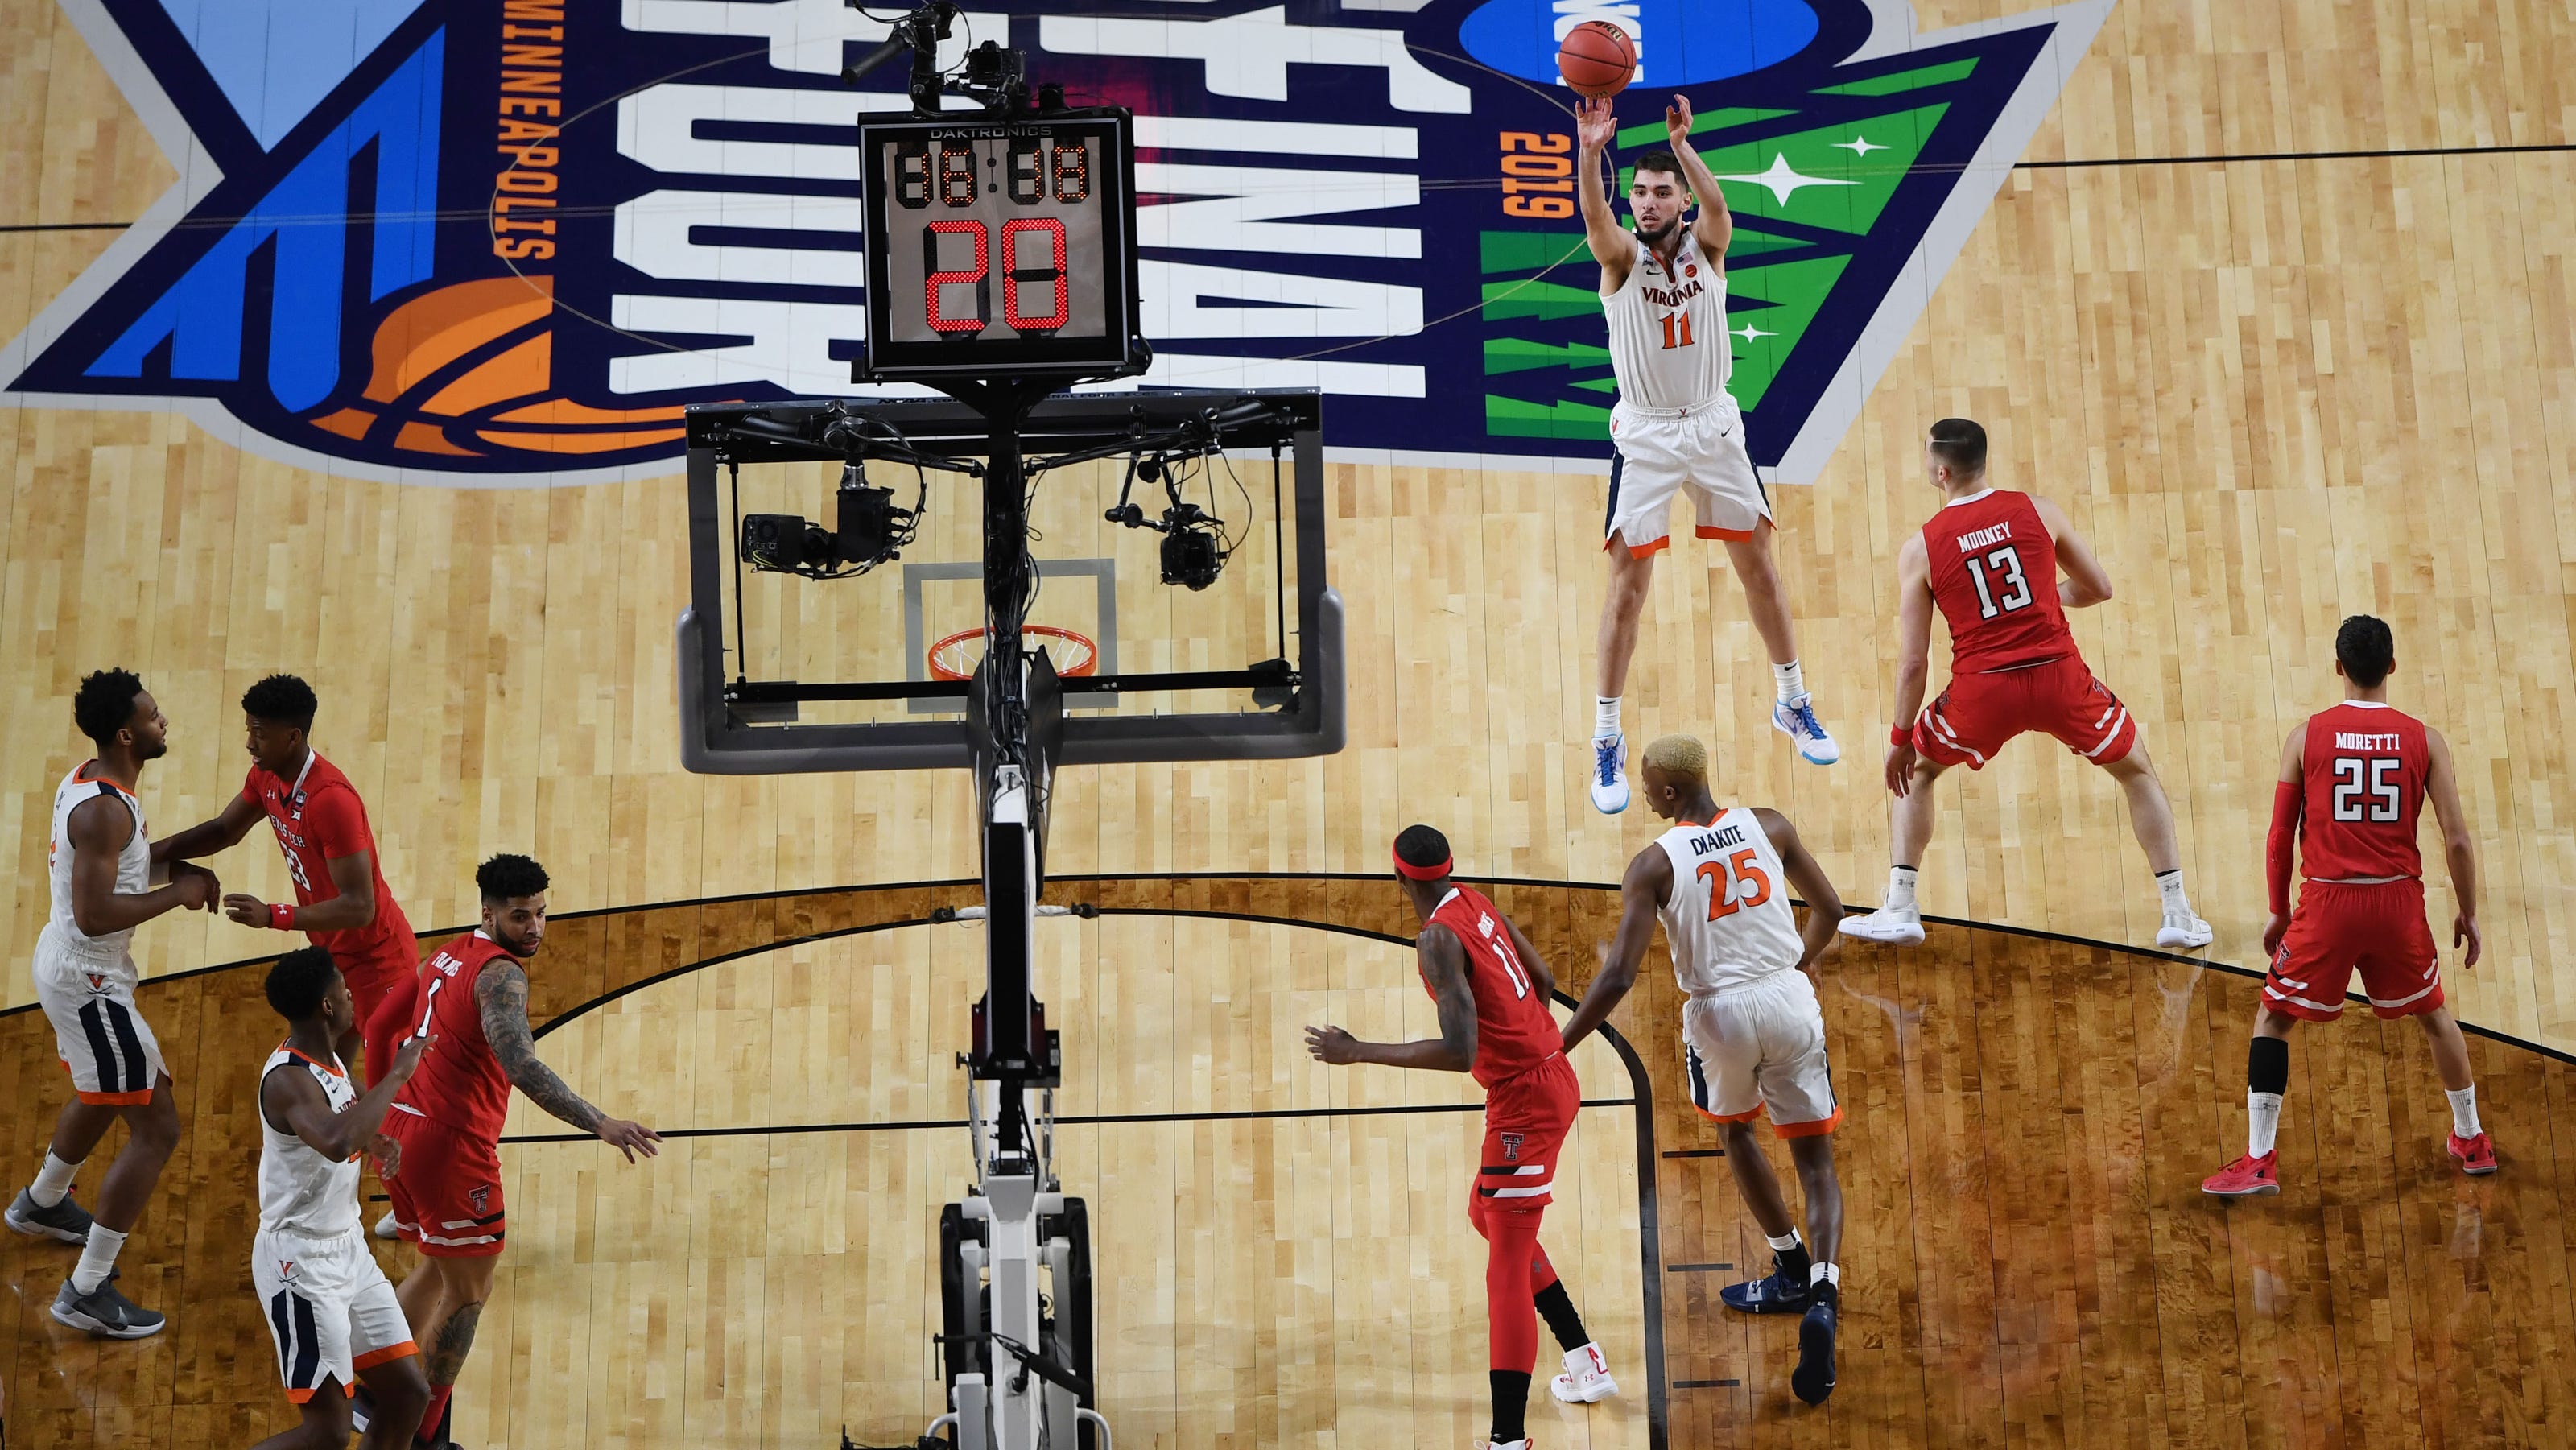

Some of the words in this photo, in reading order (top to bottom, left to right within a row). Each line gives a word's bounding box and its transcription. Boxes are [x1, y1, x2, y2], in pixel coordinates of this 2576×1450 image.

[493, 0, 564, 259] MINNEAPOLIS
[931, 126, 1051, 139] DAKTRONICS
[1500, 131, 1574, 219] 2019
[923, 217, 1069, 332] 20
[1641, 279, 1703, 307] VIRGINIA
[1658, 308, 1695, 349] 11
[1956, 521, 2012, 553] MOONEY
[1966, 545, 2033, 620] 13
[2335, 732, 2400, 750] MORETTI
[2334, 758, 2401, 822] 25
[1690, 825, 1745, 856] DIAKITE
[1696, 848, 1771, 922] 25
[1492, 932, 1530, 1001] 11
[415, 977, 442, 1039] 1
